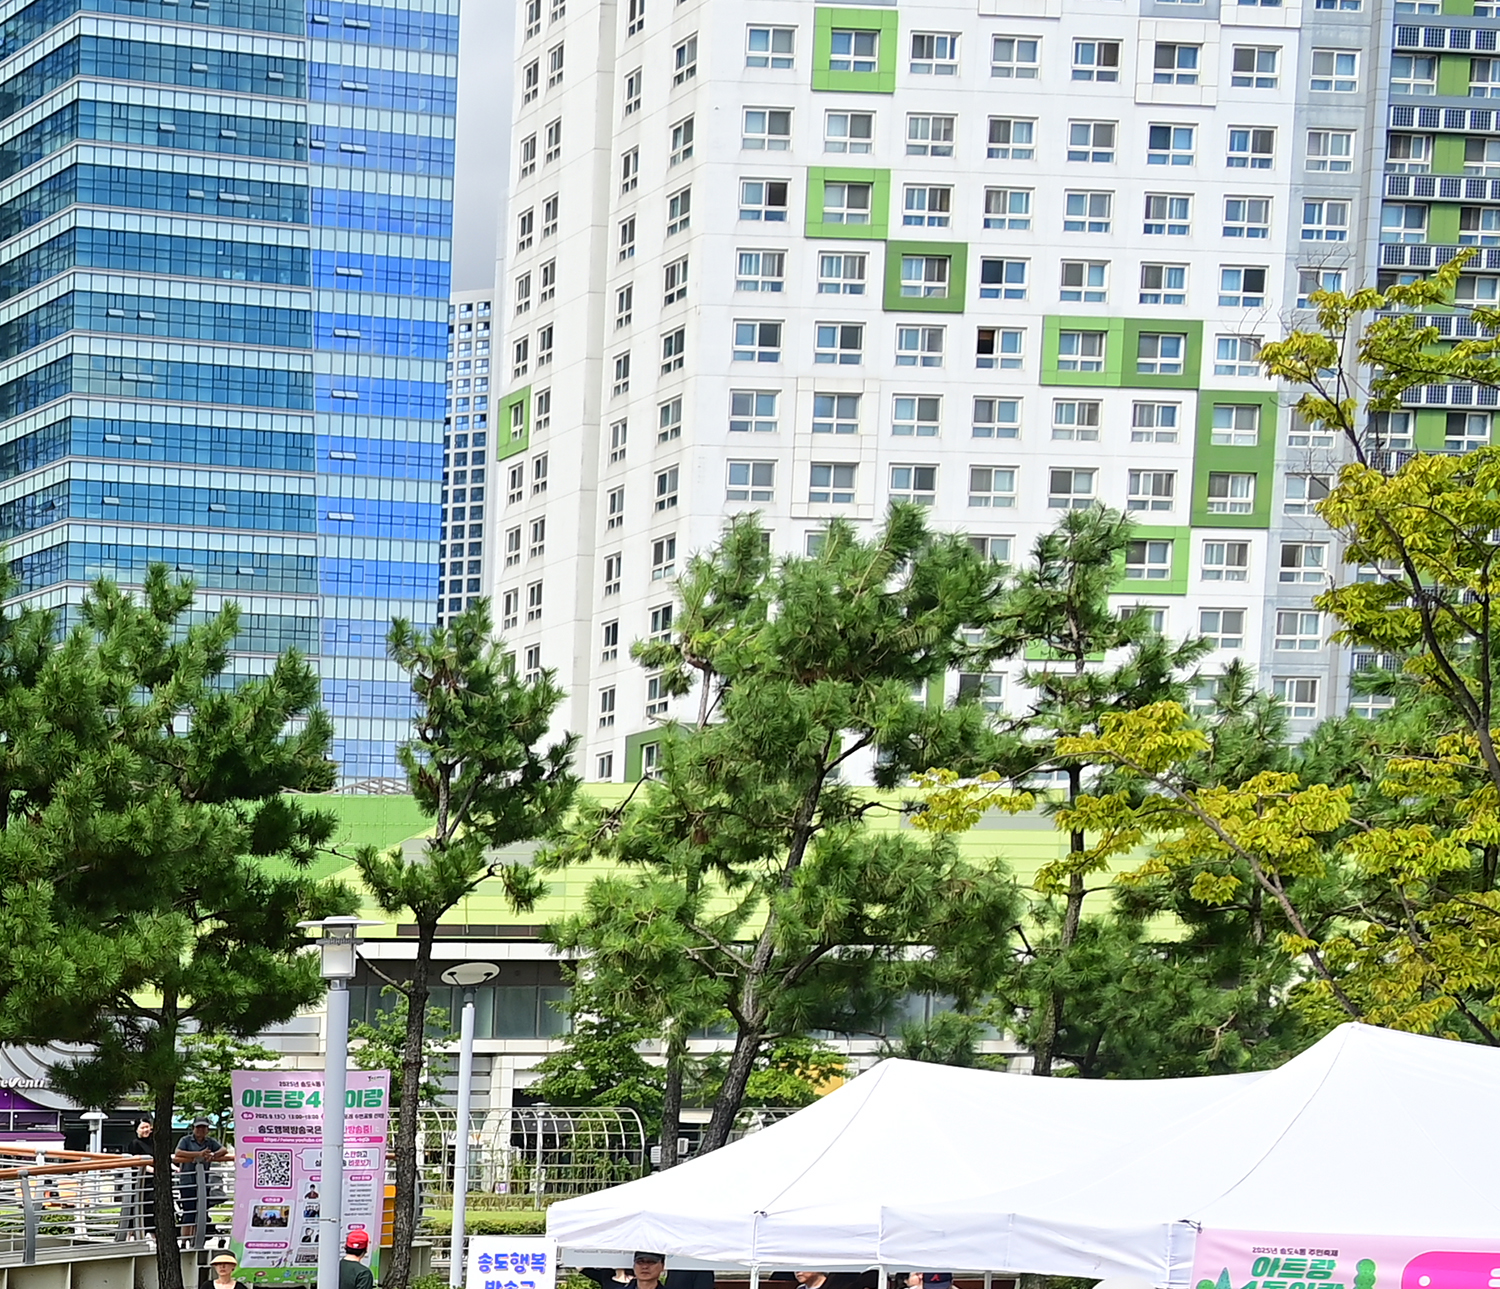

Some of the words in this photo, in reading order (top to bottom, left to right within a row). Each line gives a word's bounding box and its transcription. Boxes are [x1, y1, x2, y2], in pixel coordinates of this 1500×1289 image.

[242, 1089, 305, 1108] 아트랑
[305, 1089, 384, 1108] 4이랑
[1252, 1246, 1278, 1255] 2025년
[1308, 1248, 1339, 1257] 주민축제
[478, 1252, 547, 1274] 송도행복
[1251, 1256, 1336, 1280] 아트랑
